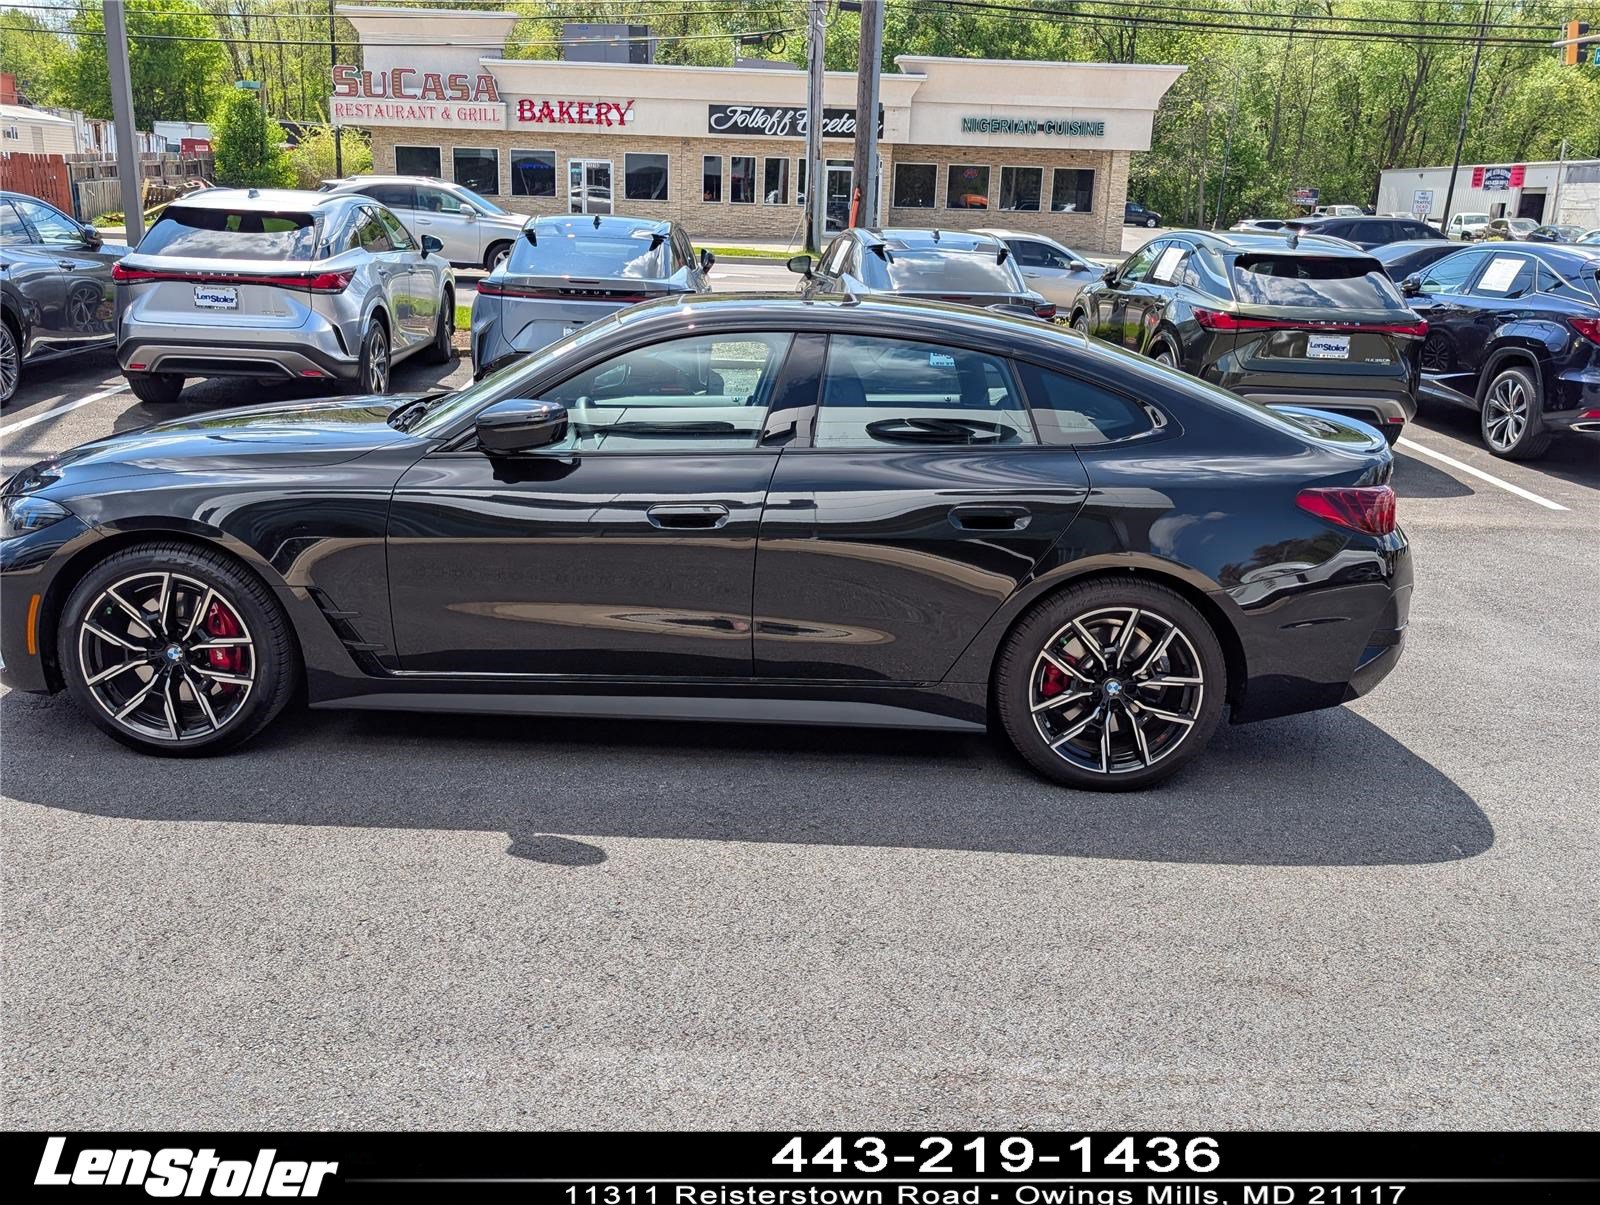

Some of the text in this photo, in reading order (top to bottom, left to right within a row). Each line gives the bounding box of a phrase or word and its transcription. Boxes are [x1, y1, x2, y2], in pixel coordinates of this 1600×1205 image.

[335, 103, 500, 122] RESTAURANT & GRILL
[518, 99, 635, 126] BAKERY
[961, 117, 1105, 137] NIGERIAN CUISINE
